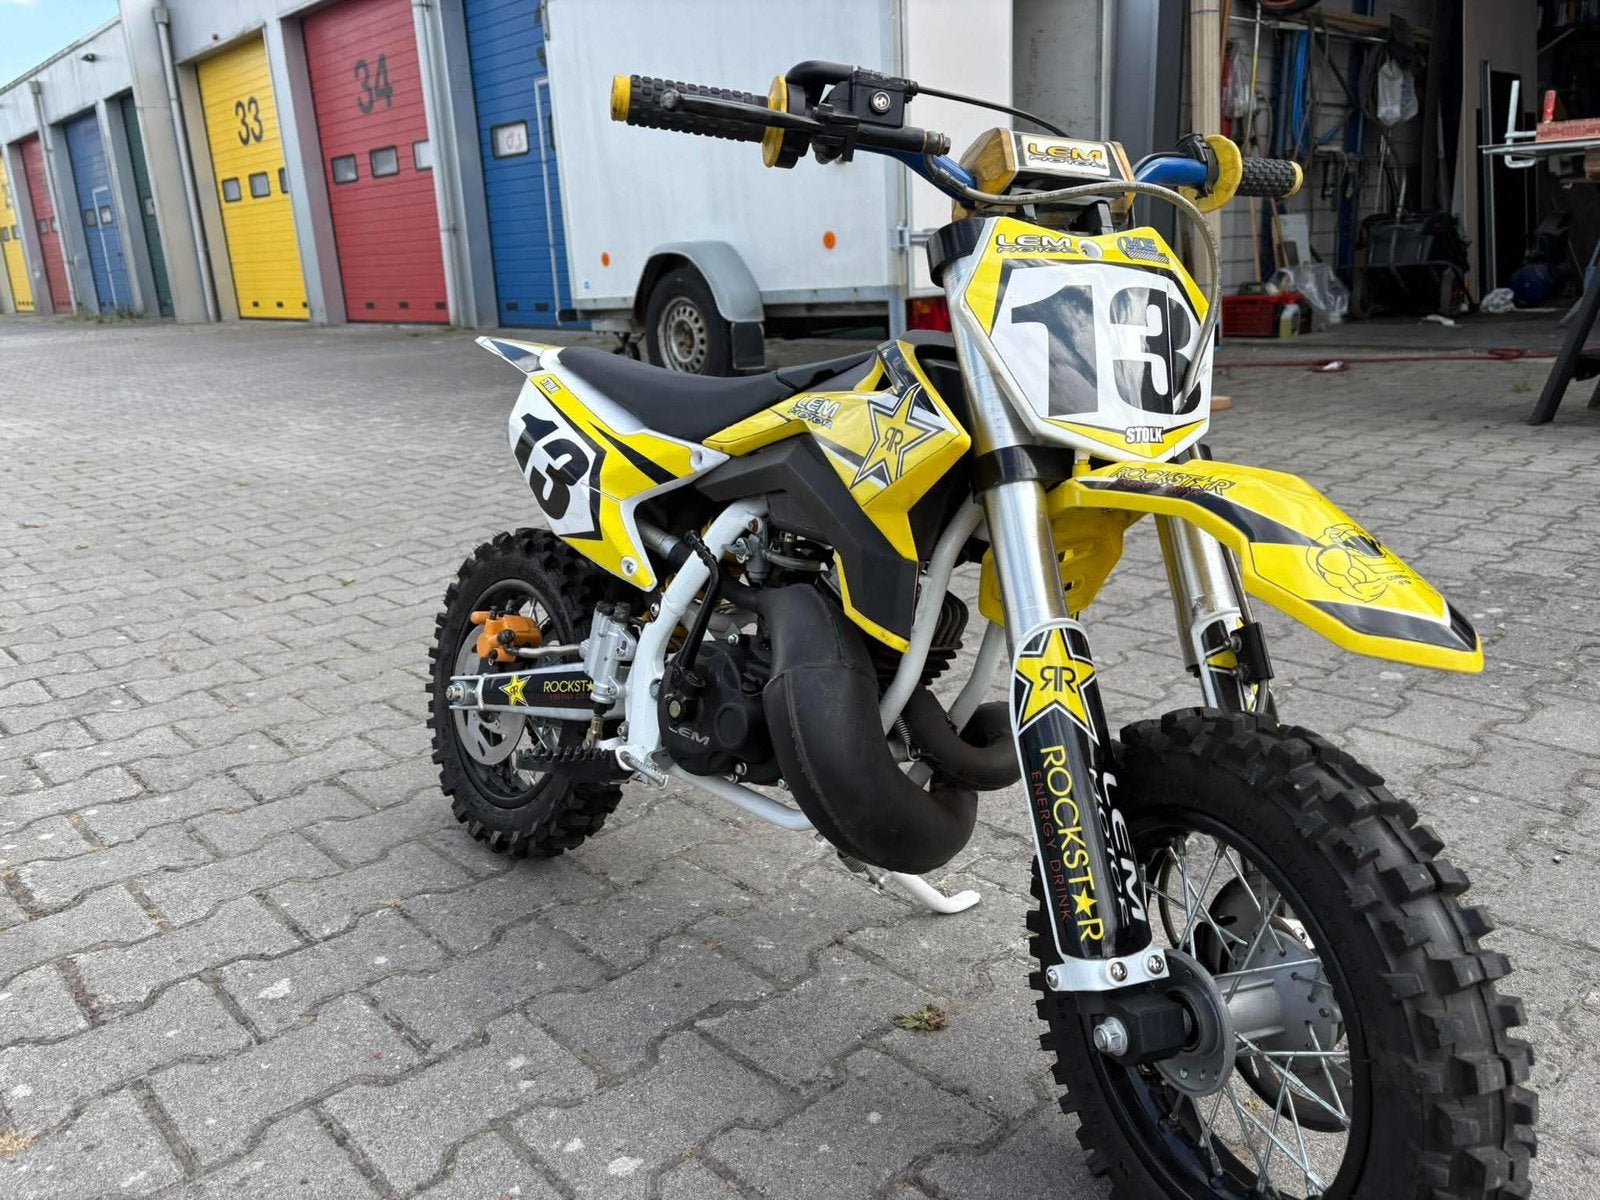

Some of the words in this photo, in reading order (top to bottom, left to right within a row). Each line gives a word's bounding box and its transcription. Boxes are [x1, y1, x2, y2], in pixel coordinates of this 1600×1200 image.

[355, 54, 393, 116] 34
[235, 96, 263, 146] 33
[1028, 143, 1102, 160] LEM
[996, 234, 1073, 247] LEM
[1011, 284, 1202, 416] 13
[795, 395, 841, 418] LEM
[1125, 426, 1164, 444] STOLK
[514, 412, 590, 520] 13
[668, 726, 710, 746] LEM
[1031, 769, 1056, 850] ENERGY
[1048, 856, 1073, 923] DRINK
[1089, 767, 1130, 928] MOTOR
[1103, 771, 1147, 922] LEM
